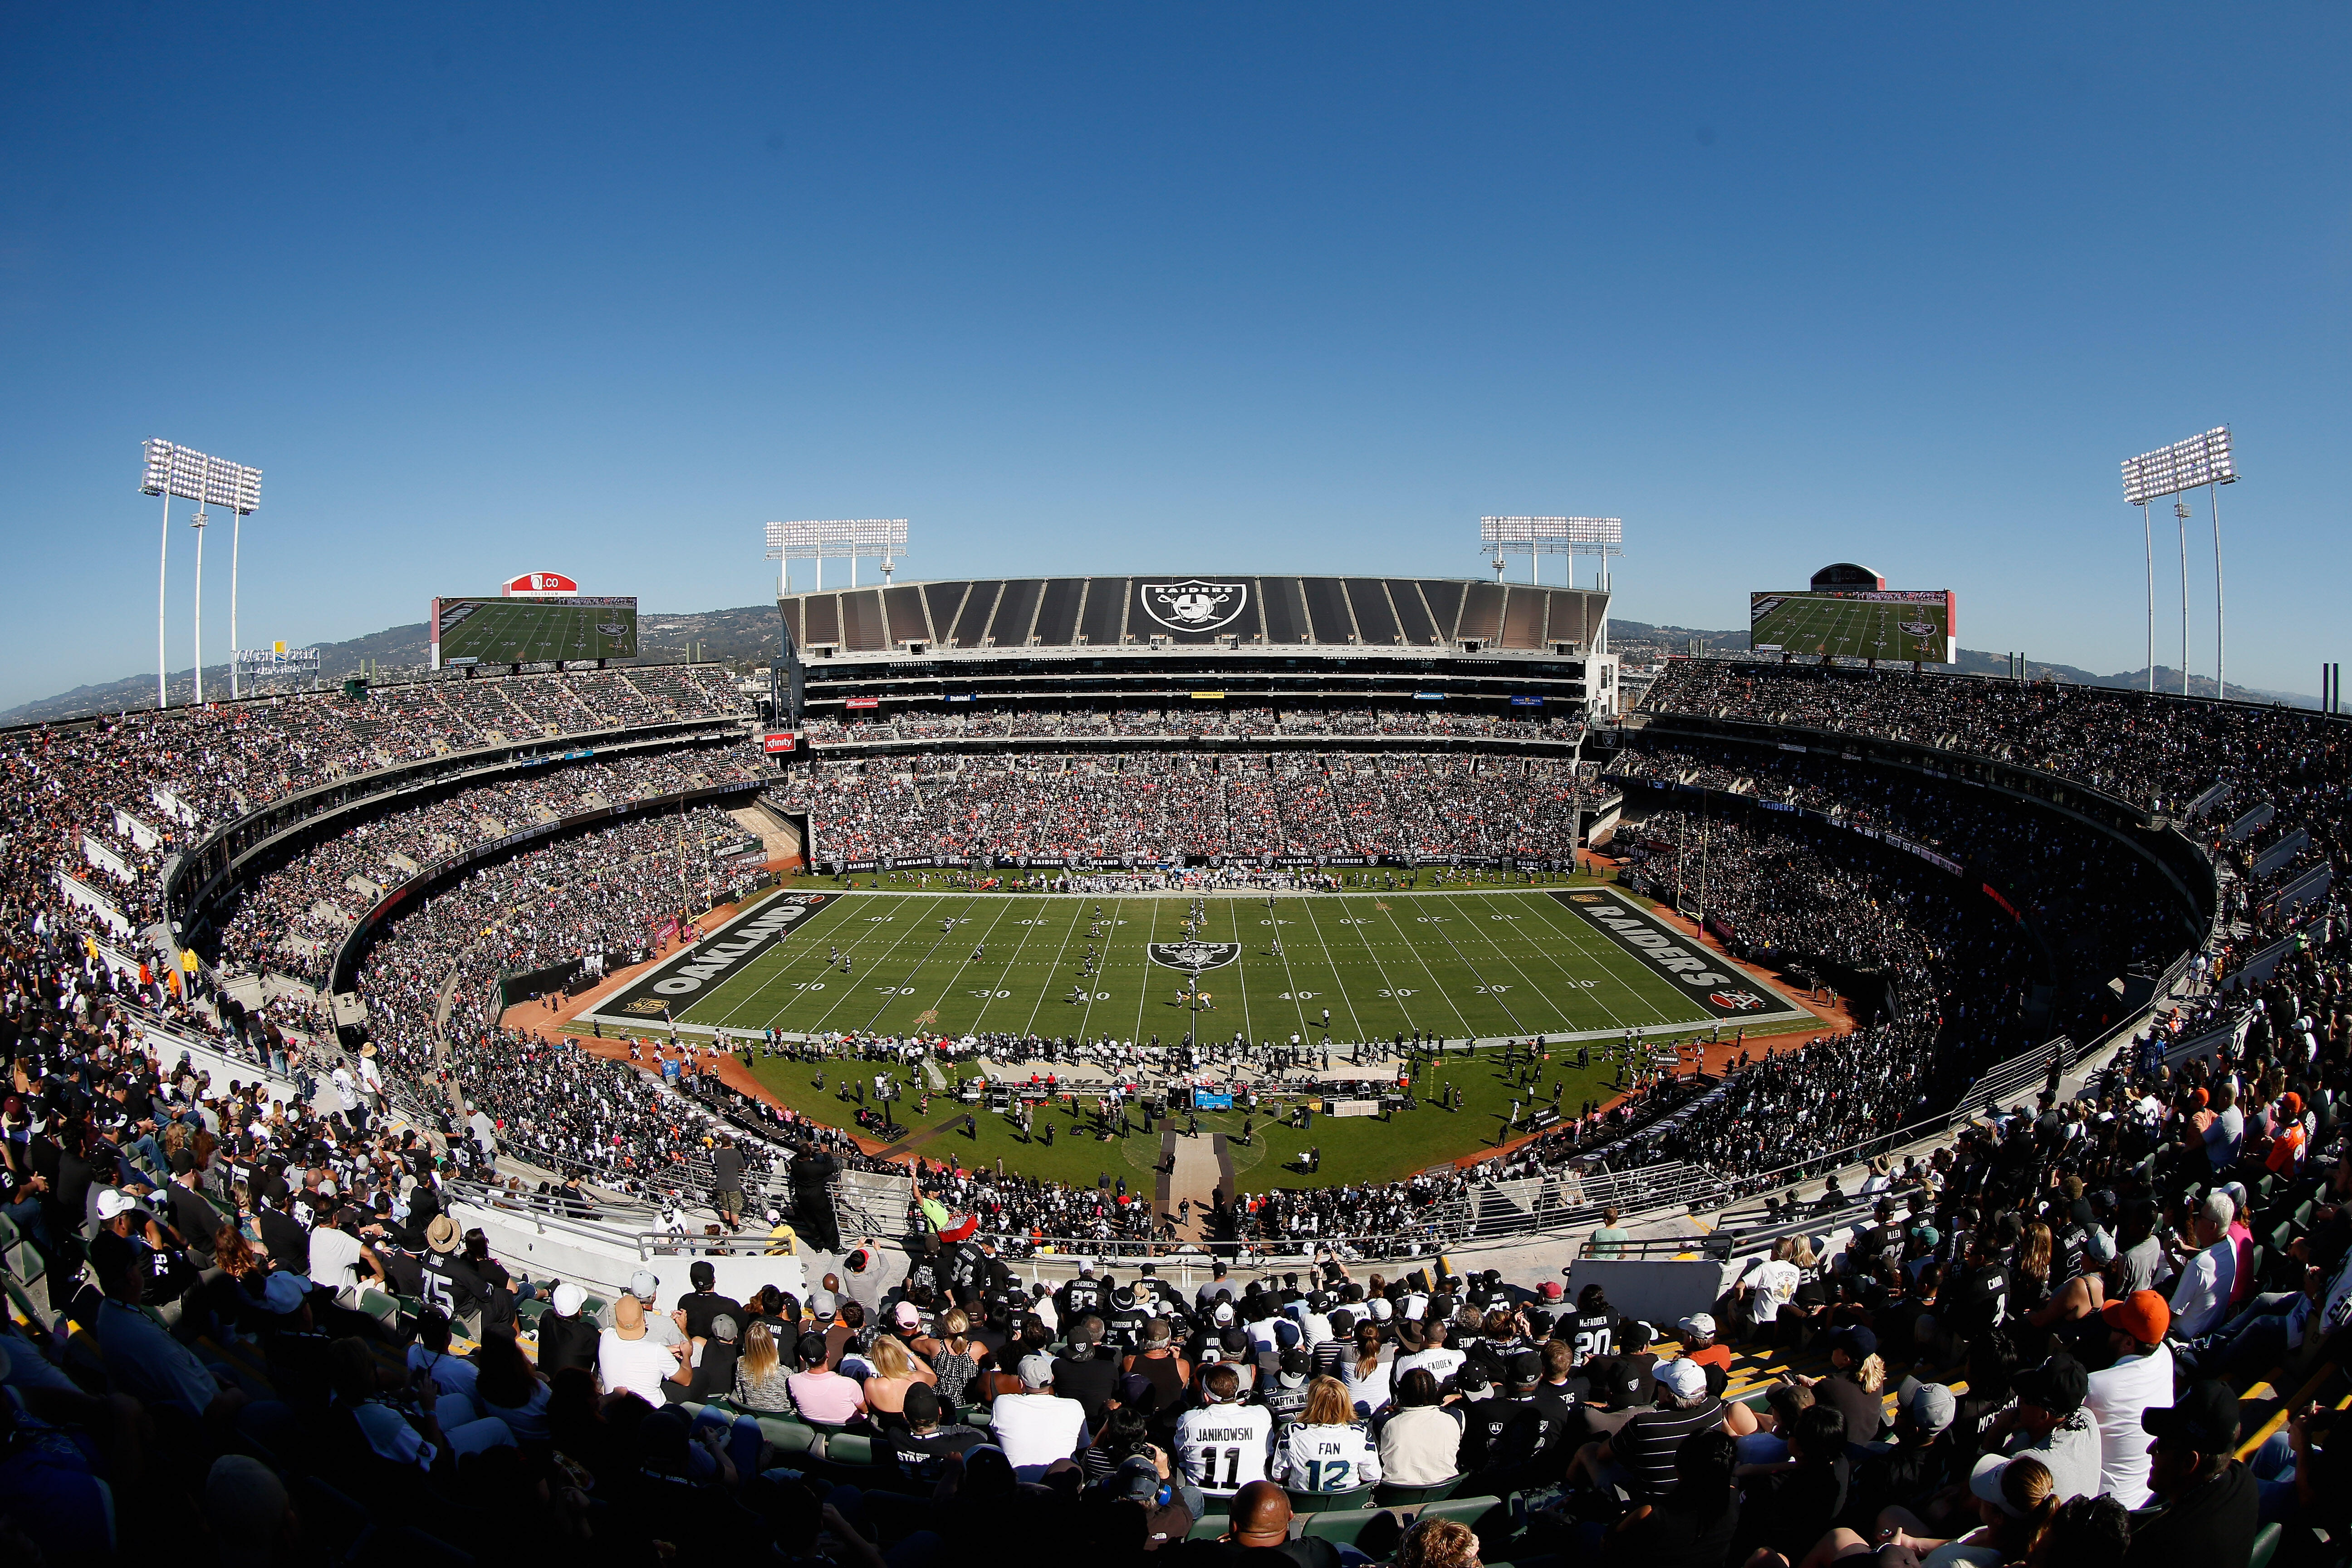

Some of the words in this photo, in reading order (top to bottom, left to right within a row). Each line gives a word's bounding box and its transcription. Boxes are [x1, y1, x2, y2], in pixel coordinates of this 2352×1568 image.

[237, 649, 273, 663] CACHE
[287, 648, 318, 661] CREEK
[725, 781, 760, 793] RAIDERS
[1832, 818, 1841, 828] OAK
[533, 827, 544, 836] BALL
[546, 825, 552, 833] ON
[1864, 828, 1873, 838] DEN
[493, 841, 501, 849] 1ST
[502, 838, 511, 847] QTR
[1886, 835, 1899, 847] 15:00
[1624, 845, 1649, 858] PRIDE
[1902, 842, 1911, 852] 1ST
[1912, 845, 1920, 855] QTR
[1938, 858, 1949, 871] BALL
[653, 905, 806, 995] OAKLAND
[1583, 906, 1731, 986] RAIDERS
[1540, 1115, 1560, 1126] OAKLAND
[1886, 1230, 1901, 1240] ALLEN
[429, 1254, 445, 1268] LONG
[959, 1247, 976, 1262] JACKSON
[951, 1256, 974, 1287] 34
[1799, 1268, 1820, 1285] 24
[1072, 1280, 1098, 1289] HENDRICKS
[1987, 1275, 2004, 1290] CARR
[421, 1267, 455, 1312] 75
[1071, 1290, 1098, 1313] 83
[1491, 1292, 1505, 1302] JONES
[1992, 1293, 2006, 1328] 4
[1579, 1317, 1608, 1328] McFADDEN
[1574, 1328, 1611, 1366] 20
[1270, 1394, 1295, 1407] DARTH
[1196, 1427, 1253, 1442] JANIKOWSKI
[1318, 1442, 1341, 1455] FAN
[1198, 1446, 1241, 1490] 11
[1305, 1460, 1351, 1492] 12
